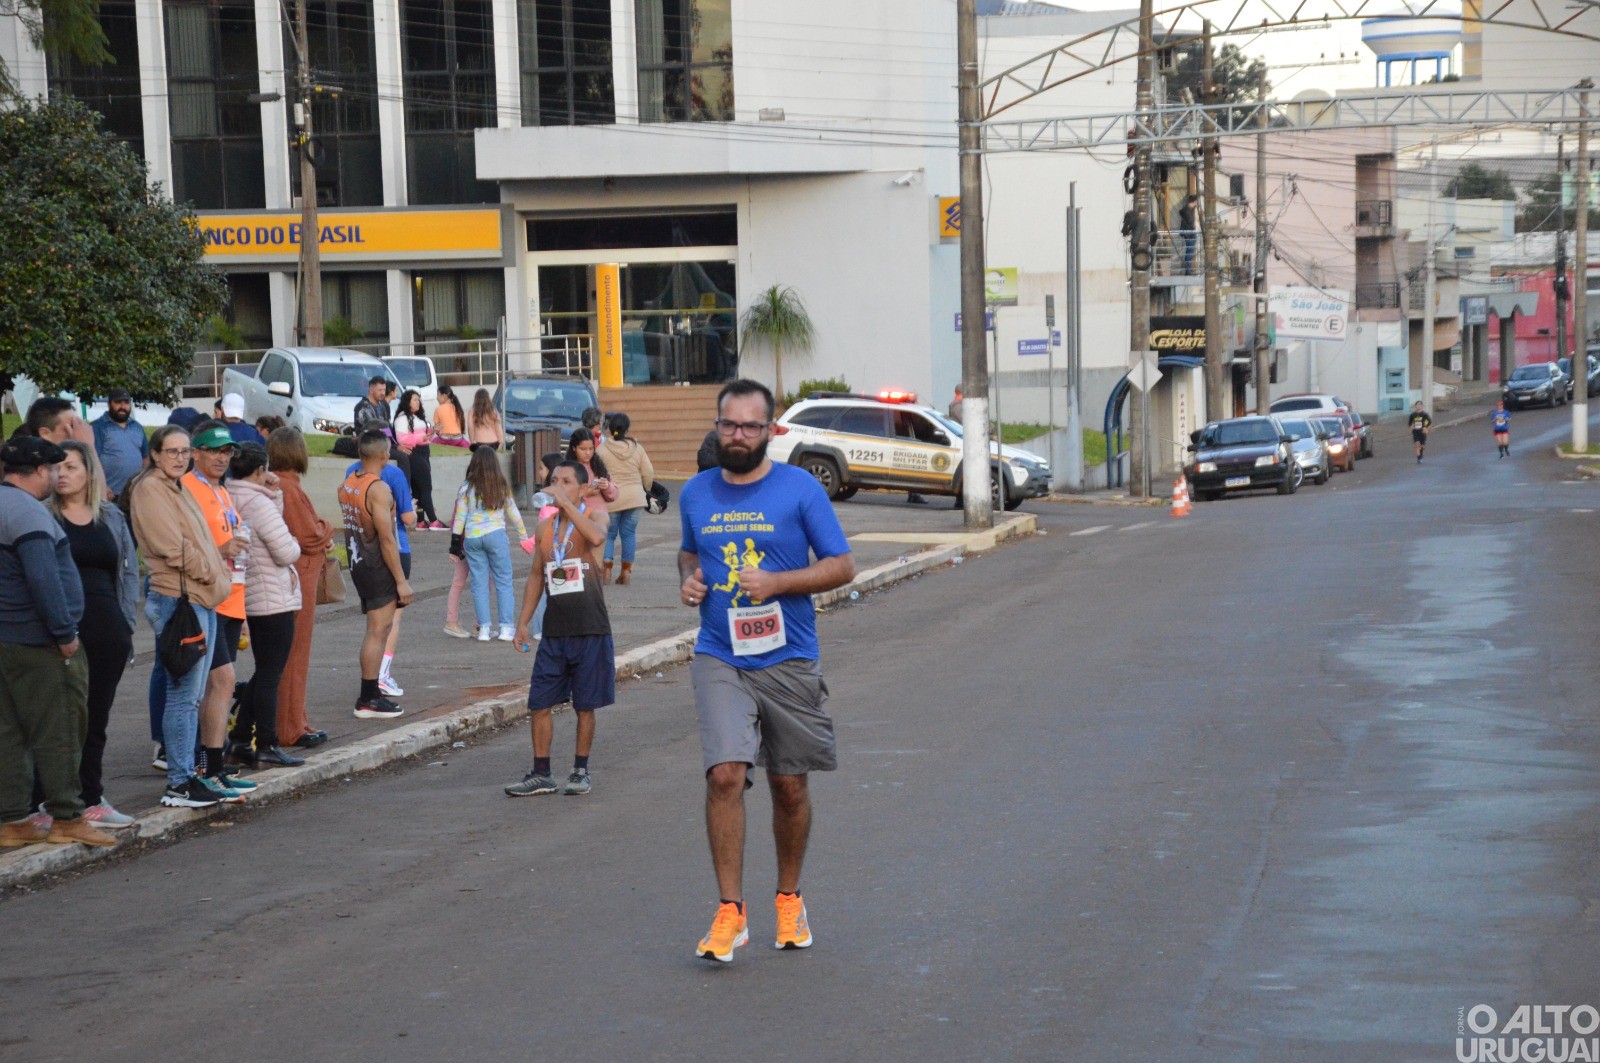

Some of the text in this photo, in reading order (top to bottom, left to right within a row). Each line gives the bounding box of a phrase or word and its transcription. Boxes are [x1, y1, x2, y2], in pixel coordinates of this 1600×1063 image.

[190, 222, 366, 245] ANCO DO BASIL
[604, 274, 613, 355] Autoatendimento
[1289, 316, 1323, 324] EXCLUSIVO
[1329, 318, 1339, 331] E
[1169, 328, 1192, 337] LOJA
[1157, 337, 1206, 348] ESPORTE
[848, 449, 884, 463] 12251
[893, 450, 928, 460] BRIGADA
[892, 457, 928, 466] MILITAR
[723, 510, 765, 522] RÚSTICA
[701, 523, 775, 534] LIONS CLUBE SEBERI
[741, 618, 776, 637] 089
